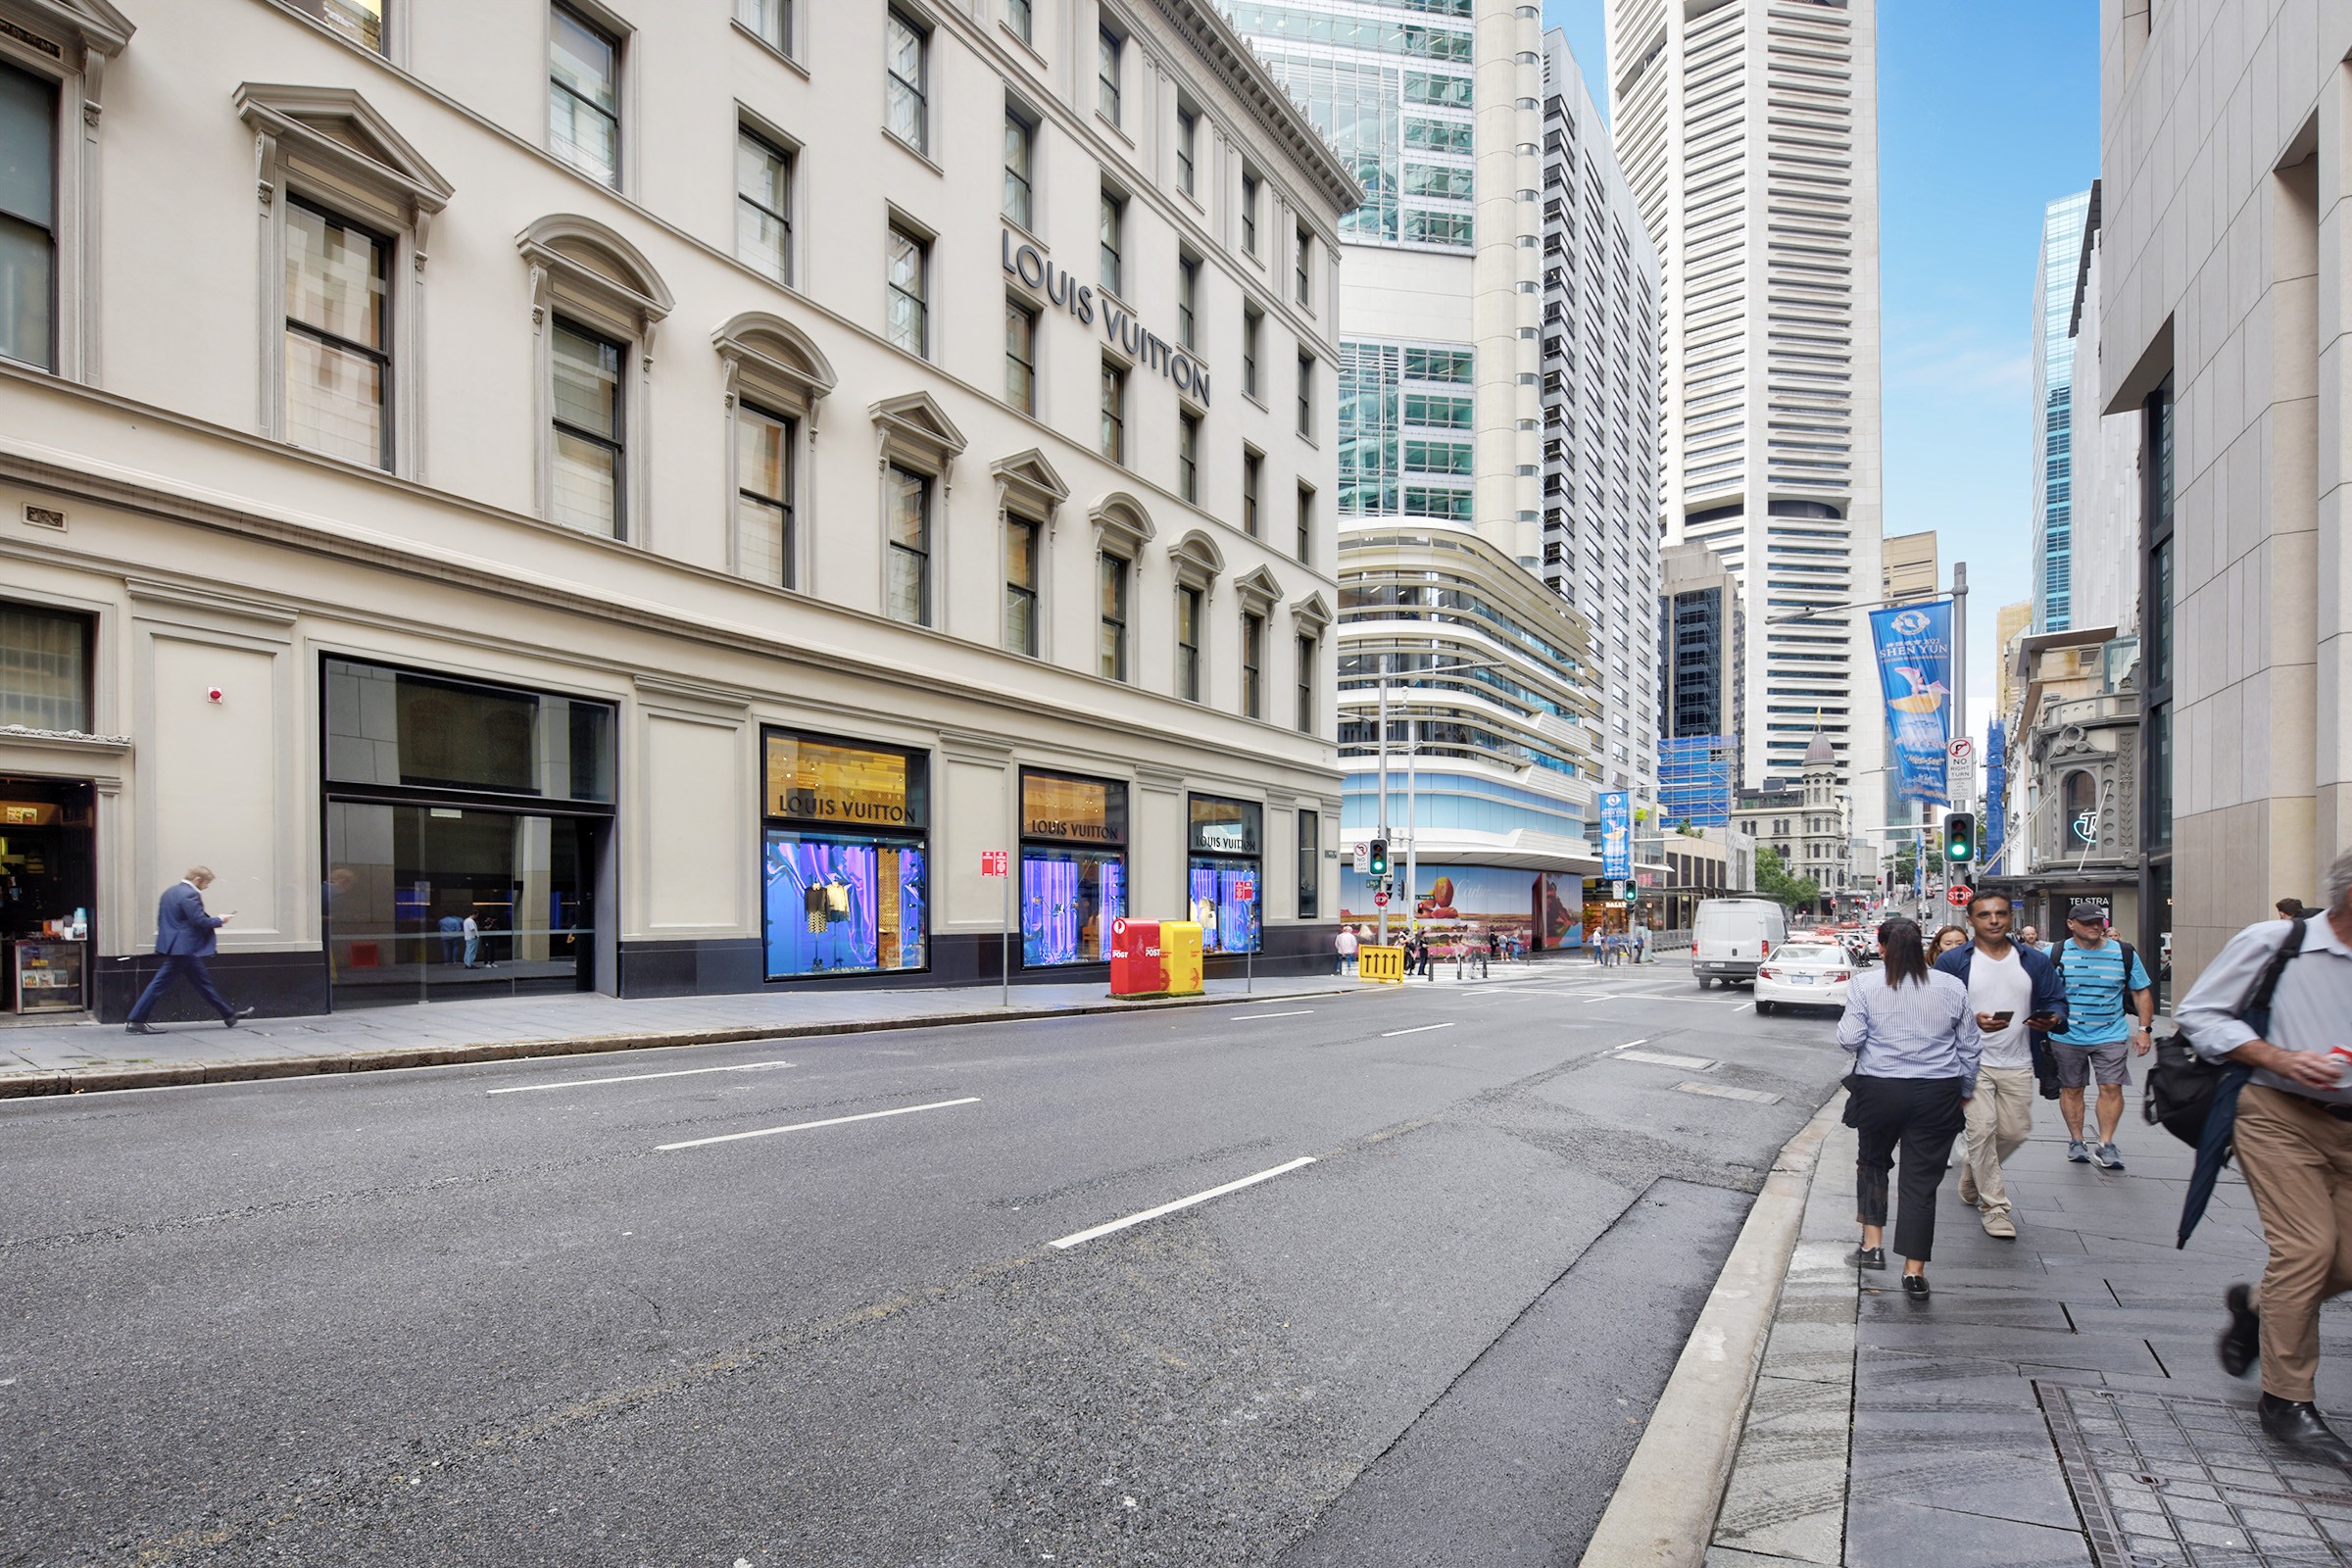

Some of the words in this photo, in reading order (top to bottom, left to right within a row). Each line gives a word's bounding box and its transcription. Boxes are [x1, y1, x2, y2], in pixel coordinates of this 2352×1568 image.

[1003, 228, 1094, 324] LOUIS
[1102, 299, 1210, 407] VUITTON
[1880, 645, 1916, 659] SHEN
[1919, 644, 1947, 654] YUN
[779, 795, 835, 815] LOUIS
[842, 801, 915, 823] VUITTON
[1032, 819, 1066, 836] LOUIS
[1070, 824, 1117, 839] VUITTON
[1197, 835, 1221, 848] LOUIS
[1223, 838, 1255, 851] VUITTON
[1948, 891, 1972, 901] STOP
[2070, 897, 2109, 906] TELSTRA
